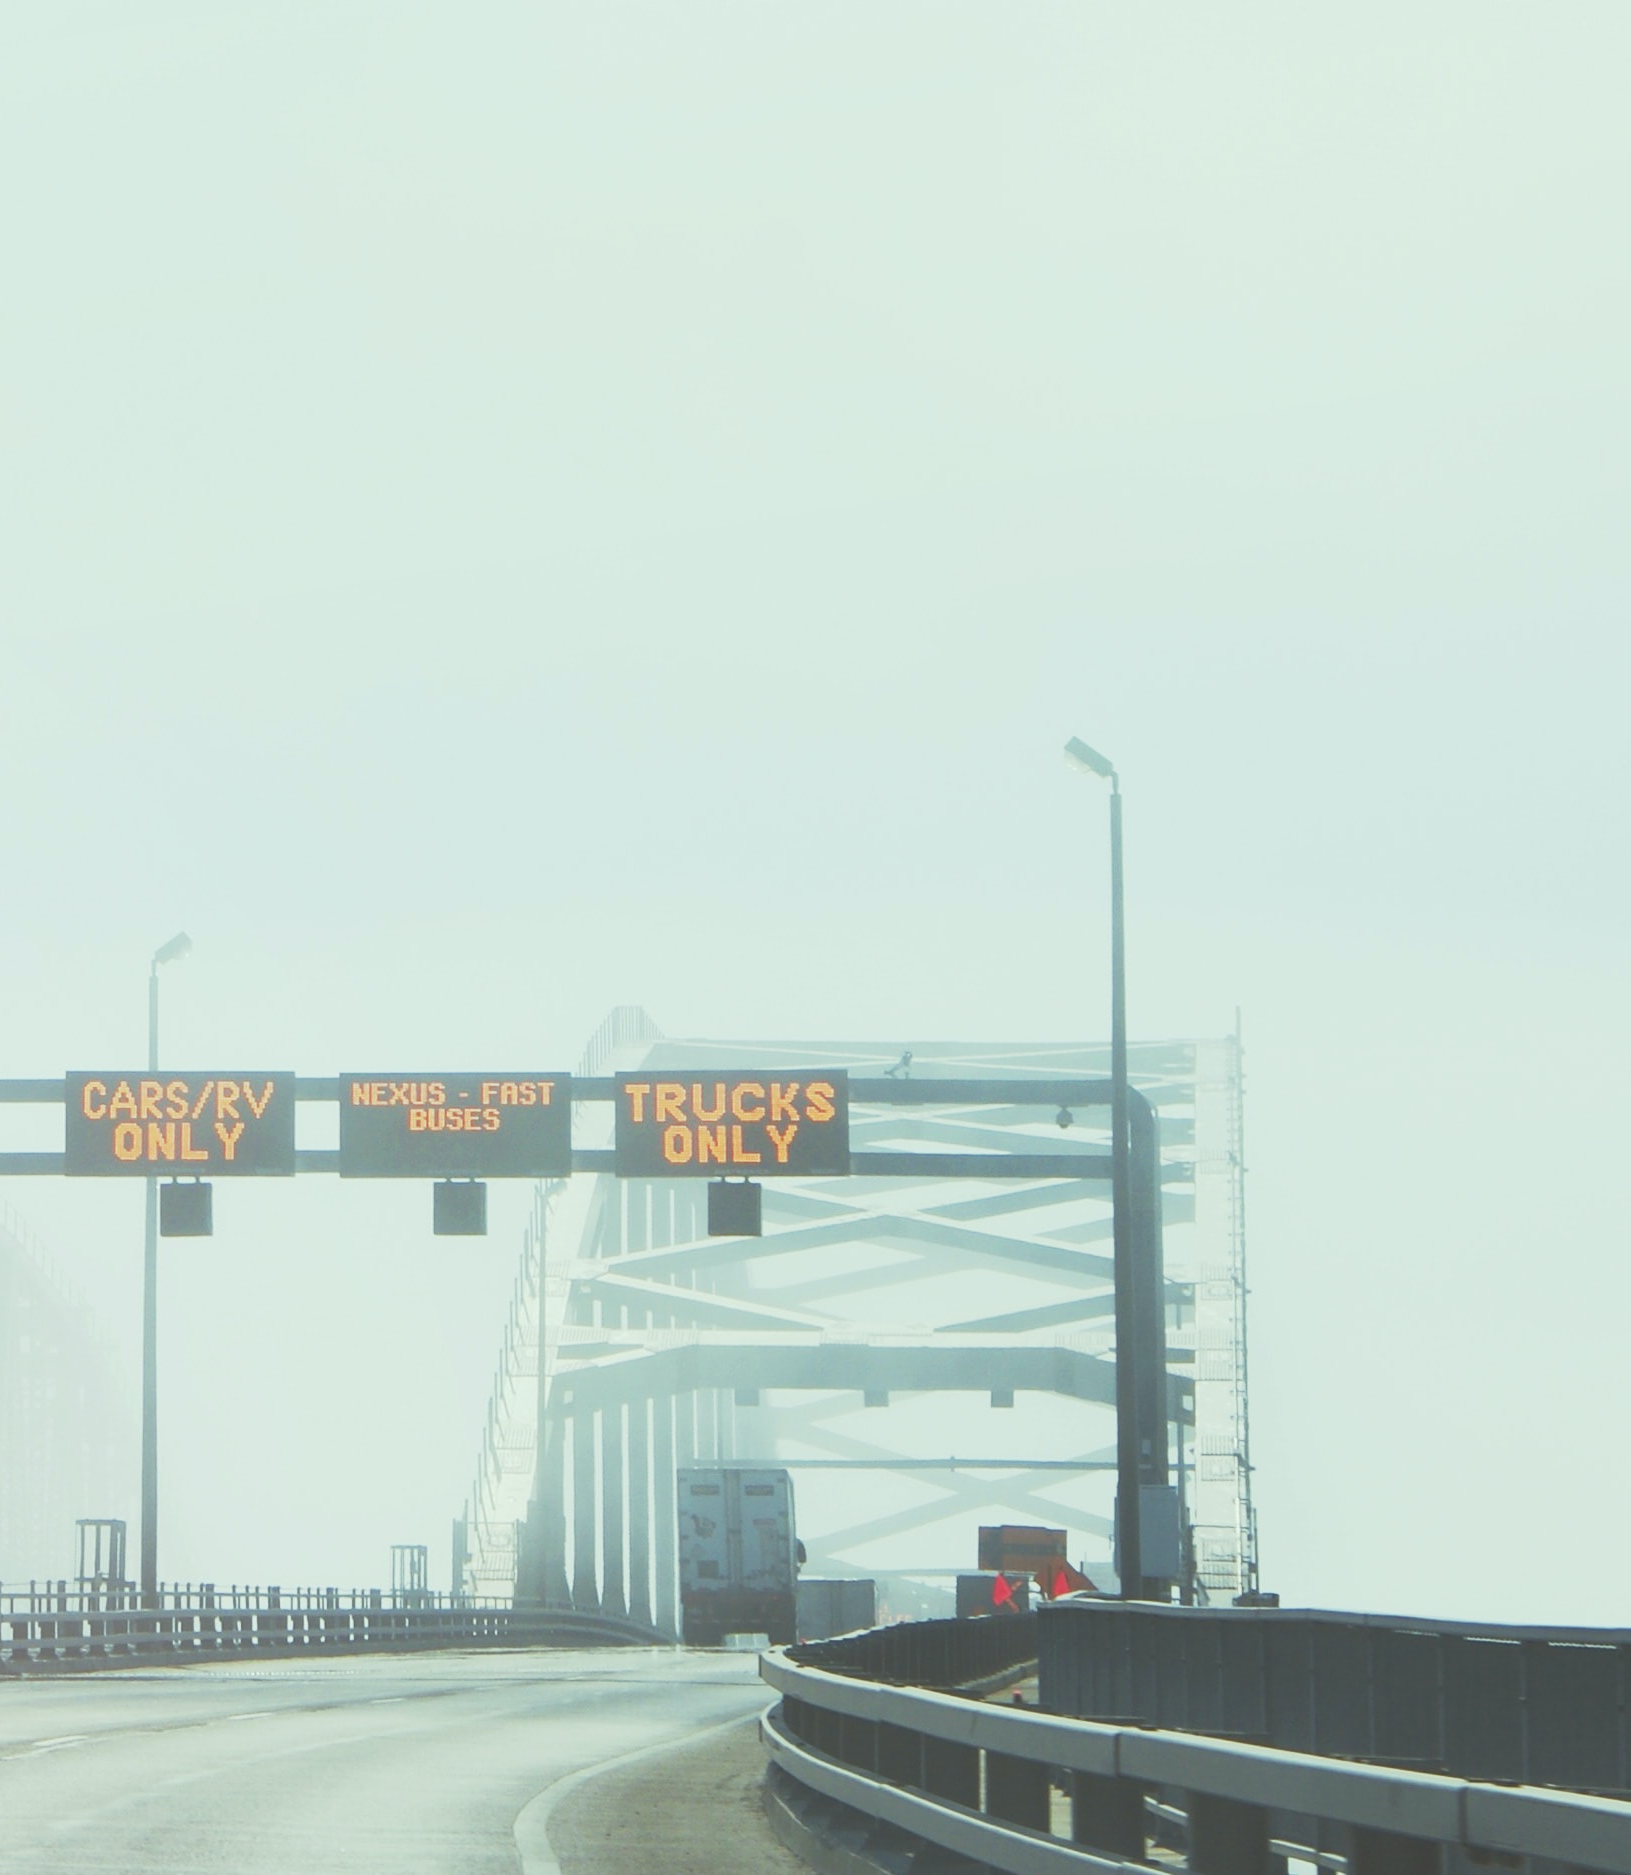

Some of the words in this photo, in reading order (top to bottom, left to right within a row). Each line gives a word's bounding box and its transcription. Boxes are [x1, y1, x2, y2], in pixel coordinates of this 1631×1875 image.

[82, 1081, 275, 1120] CARS/RV
[351, 1082, 447, 1106] NEXUS
[481, 1082, 555, 1106] FAST
[624, 1082, 837, 1123] TRUCKS
[408, 1107, 501, 1132] BUSES
[113, 1122, 246, 1162] ONLY
[662, 1124, 799, 1164] ONLY
